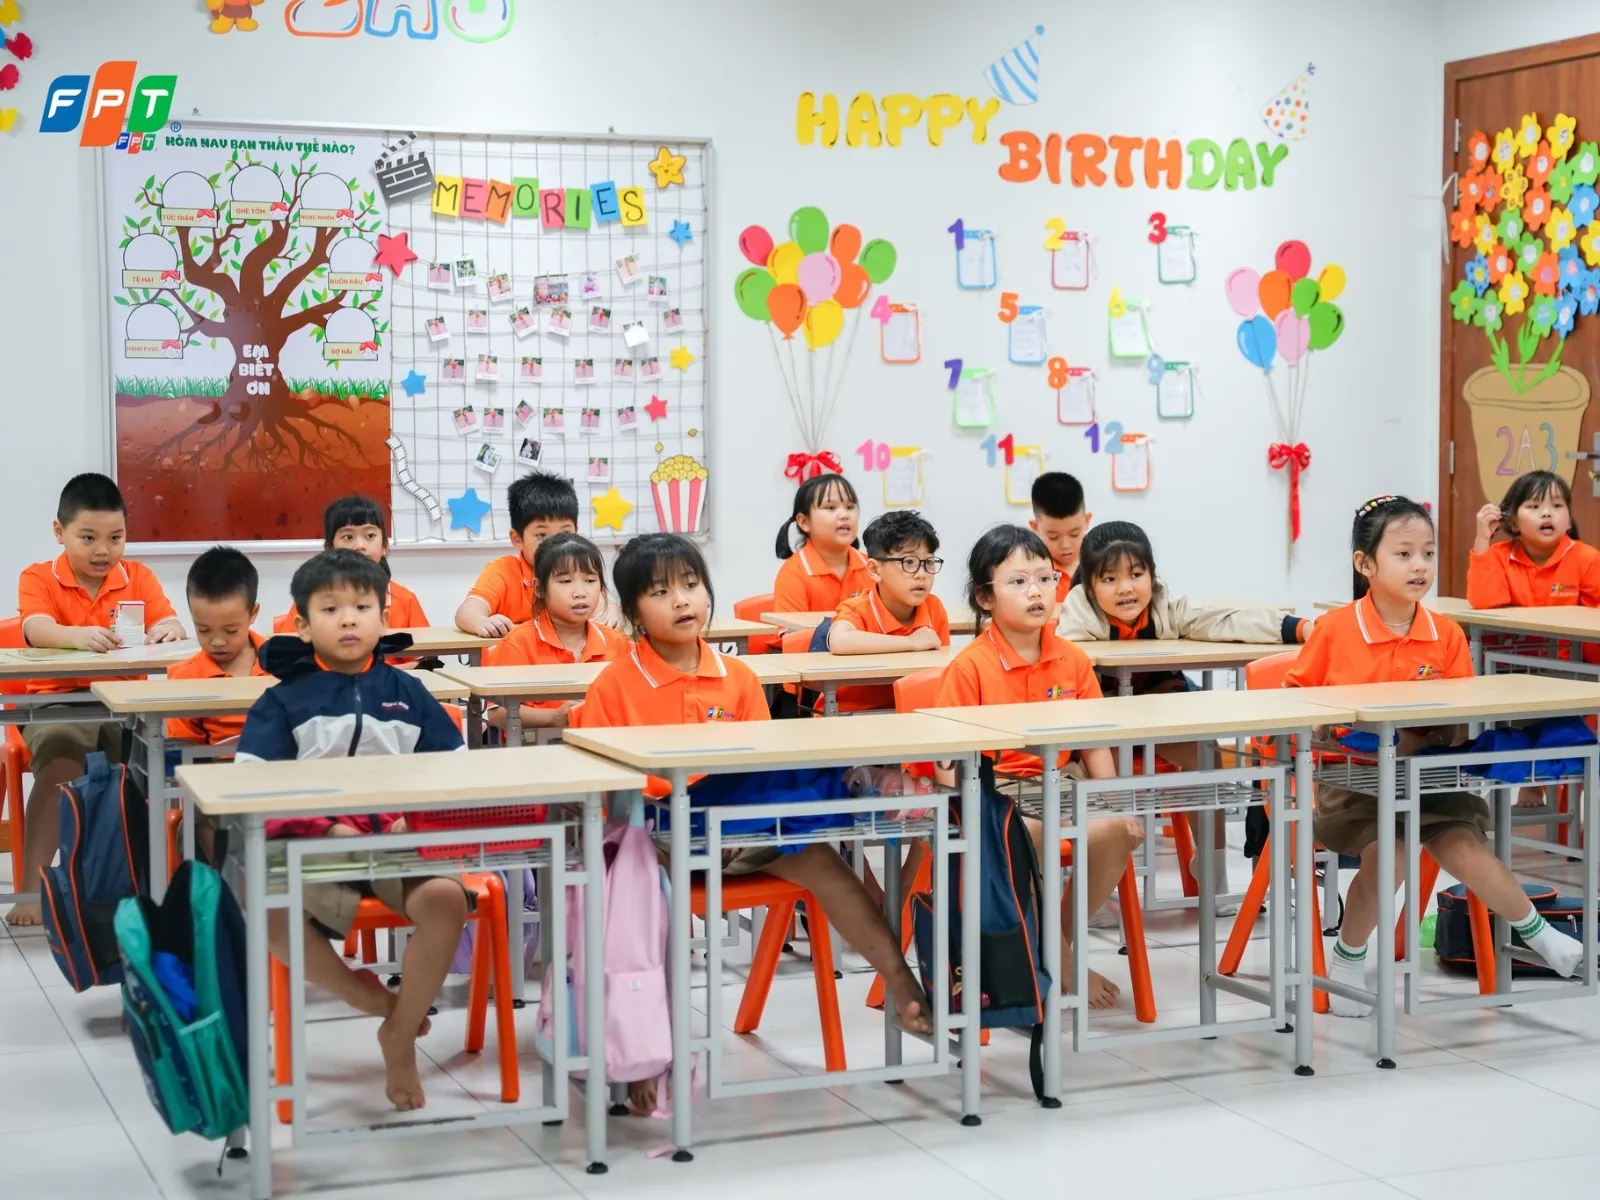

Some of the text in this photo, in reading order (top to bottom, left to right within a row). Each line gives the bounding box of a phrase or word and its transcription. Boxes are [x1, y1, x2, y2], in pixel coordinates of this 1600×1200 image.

[795, 91, 1000, 148] HAPPY
[998, 130, 1289, 191] BIRTHDAY
[436, 181, 643, 224] MEMORIES
[948, 218, 964, 251] 1
[1043, 217, 1067, 251] 2
[1148, 212, 1167, 244] 3
[870, 295, 893, 325] 4
[998, 292, 1019, 323] 5
[1108, 286, 1126, 318] 6
[238, 357, 275, 377] BIẾT
[242, 344, 270, 358] EM
[944, 359, 963, 390] 7
[1047, 356, 1069, 389] 8
[1147, 354, 1165, 385] 9
[246, 380, 271, 396] ƠN
[980, 433, 1014, 467] 11
[1084, 421, 1125, 454] 12
[1495, 423, 1559, 476] 2A3
[856, 439, 892, 472] 10
